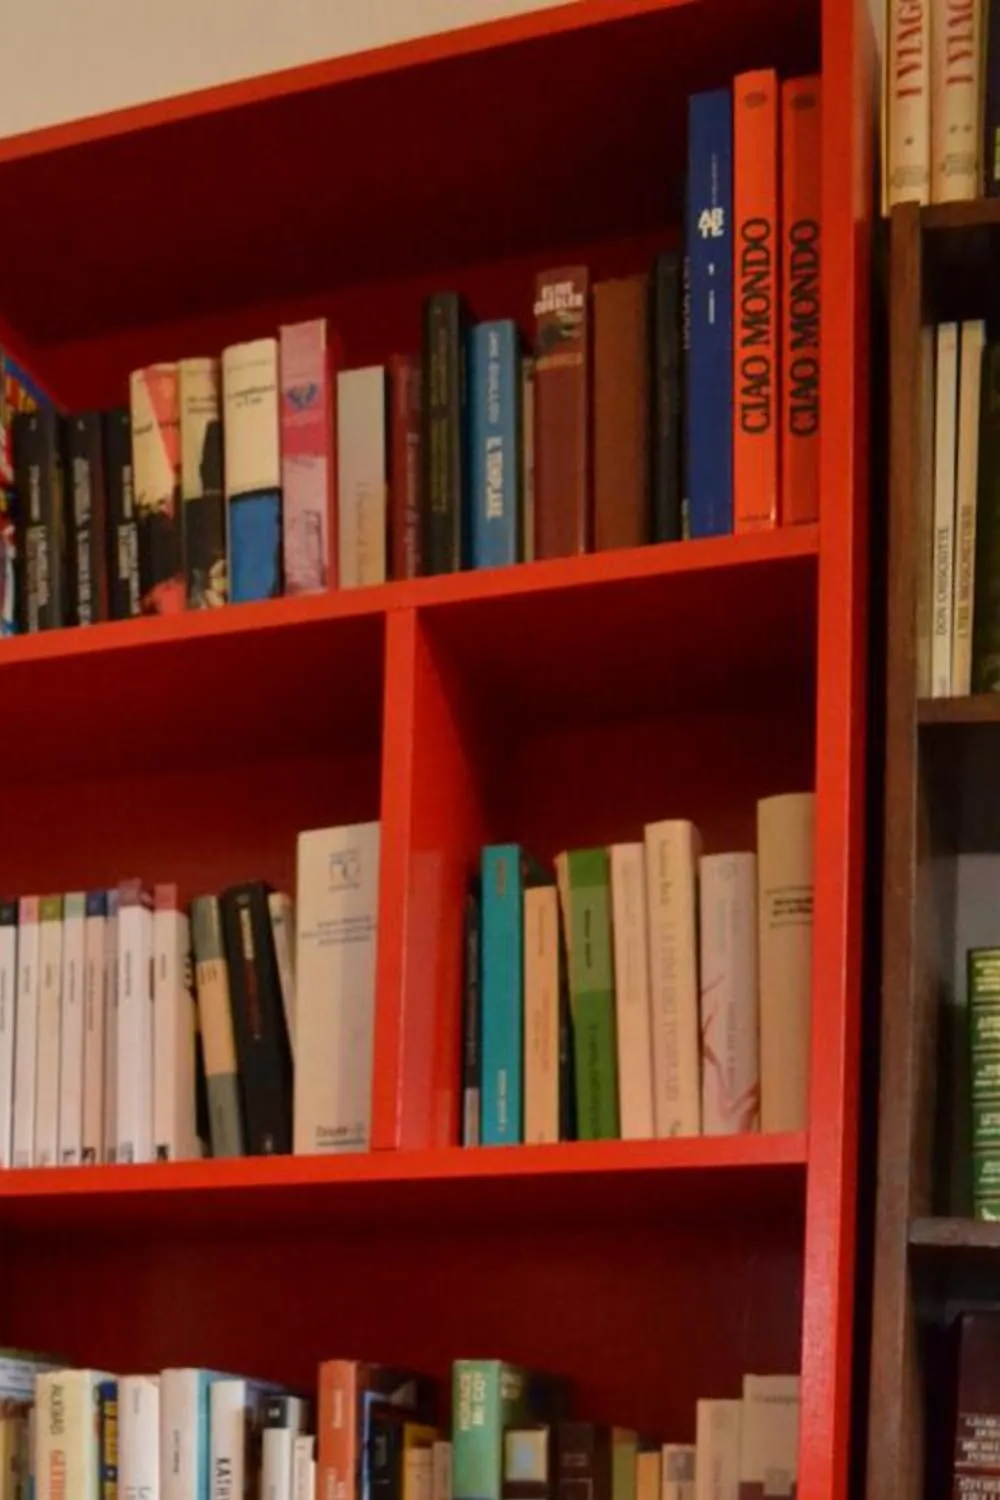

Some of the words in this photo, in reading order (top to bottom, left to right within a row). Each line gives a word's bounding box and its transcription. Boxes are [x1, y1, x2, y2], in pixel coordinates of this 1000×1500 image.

[740, 217, 771, 349] MONDO
[789, 218, 821, 352] MONDO
[740, 355, 771, 435] CIAO
[789, 357, 821, 438] CIAO
